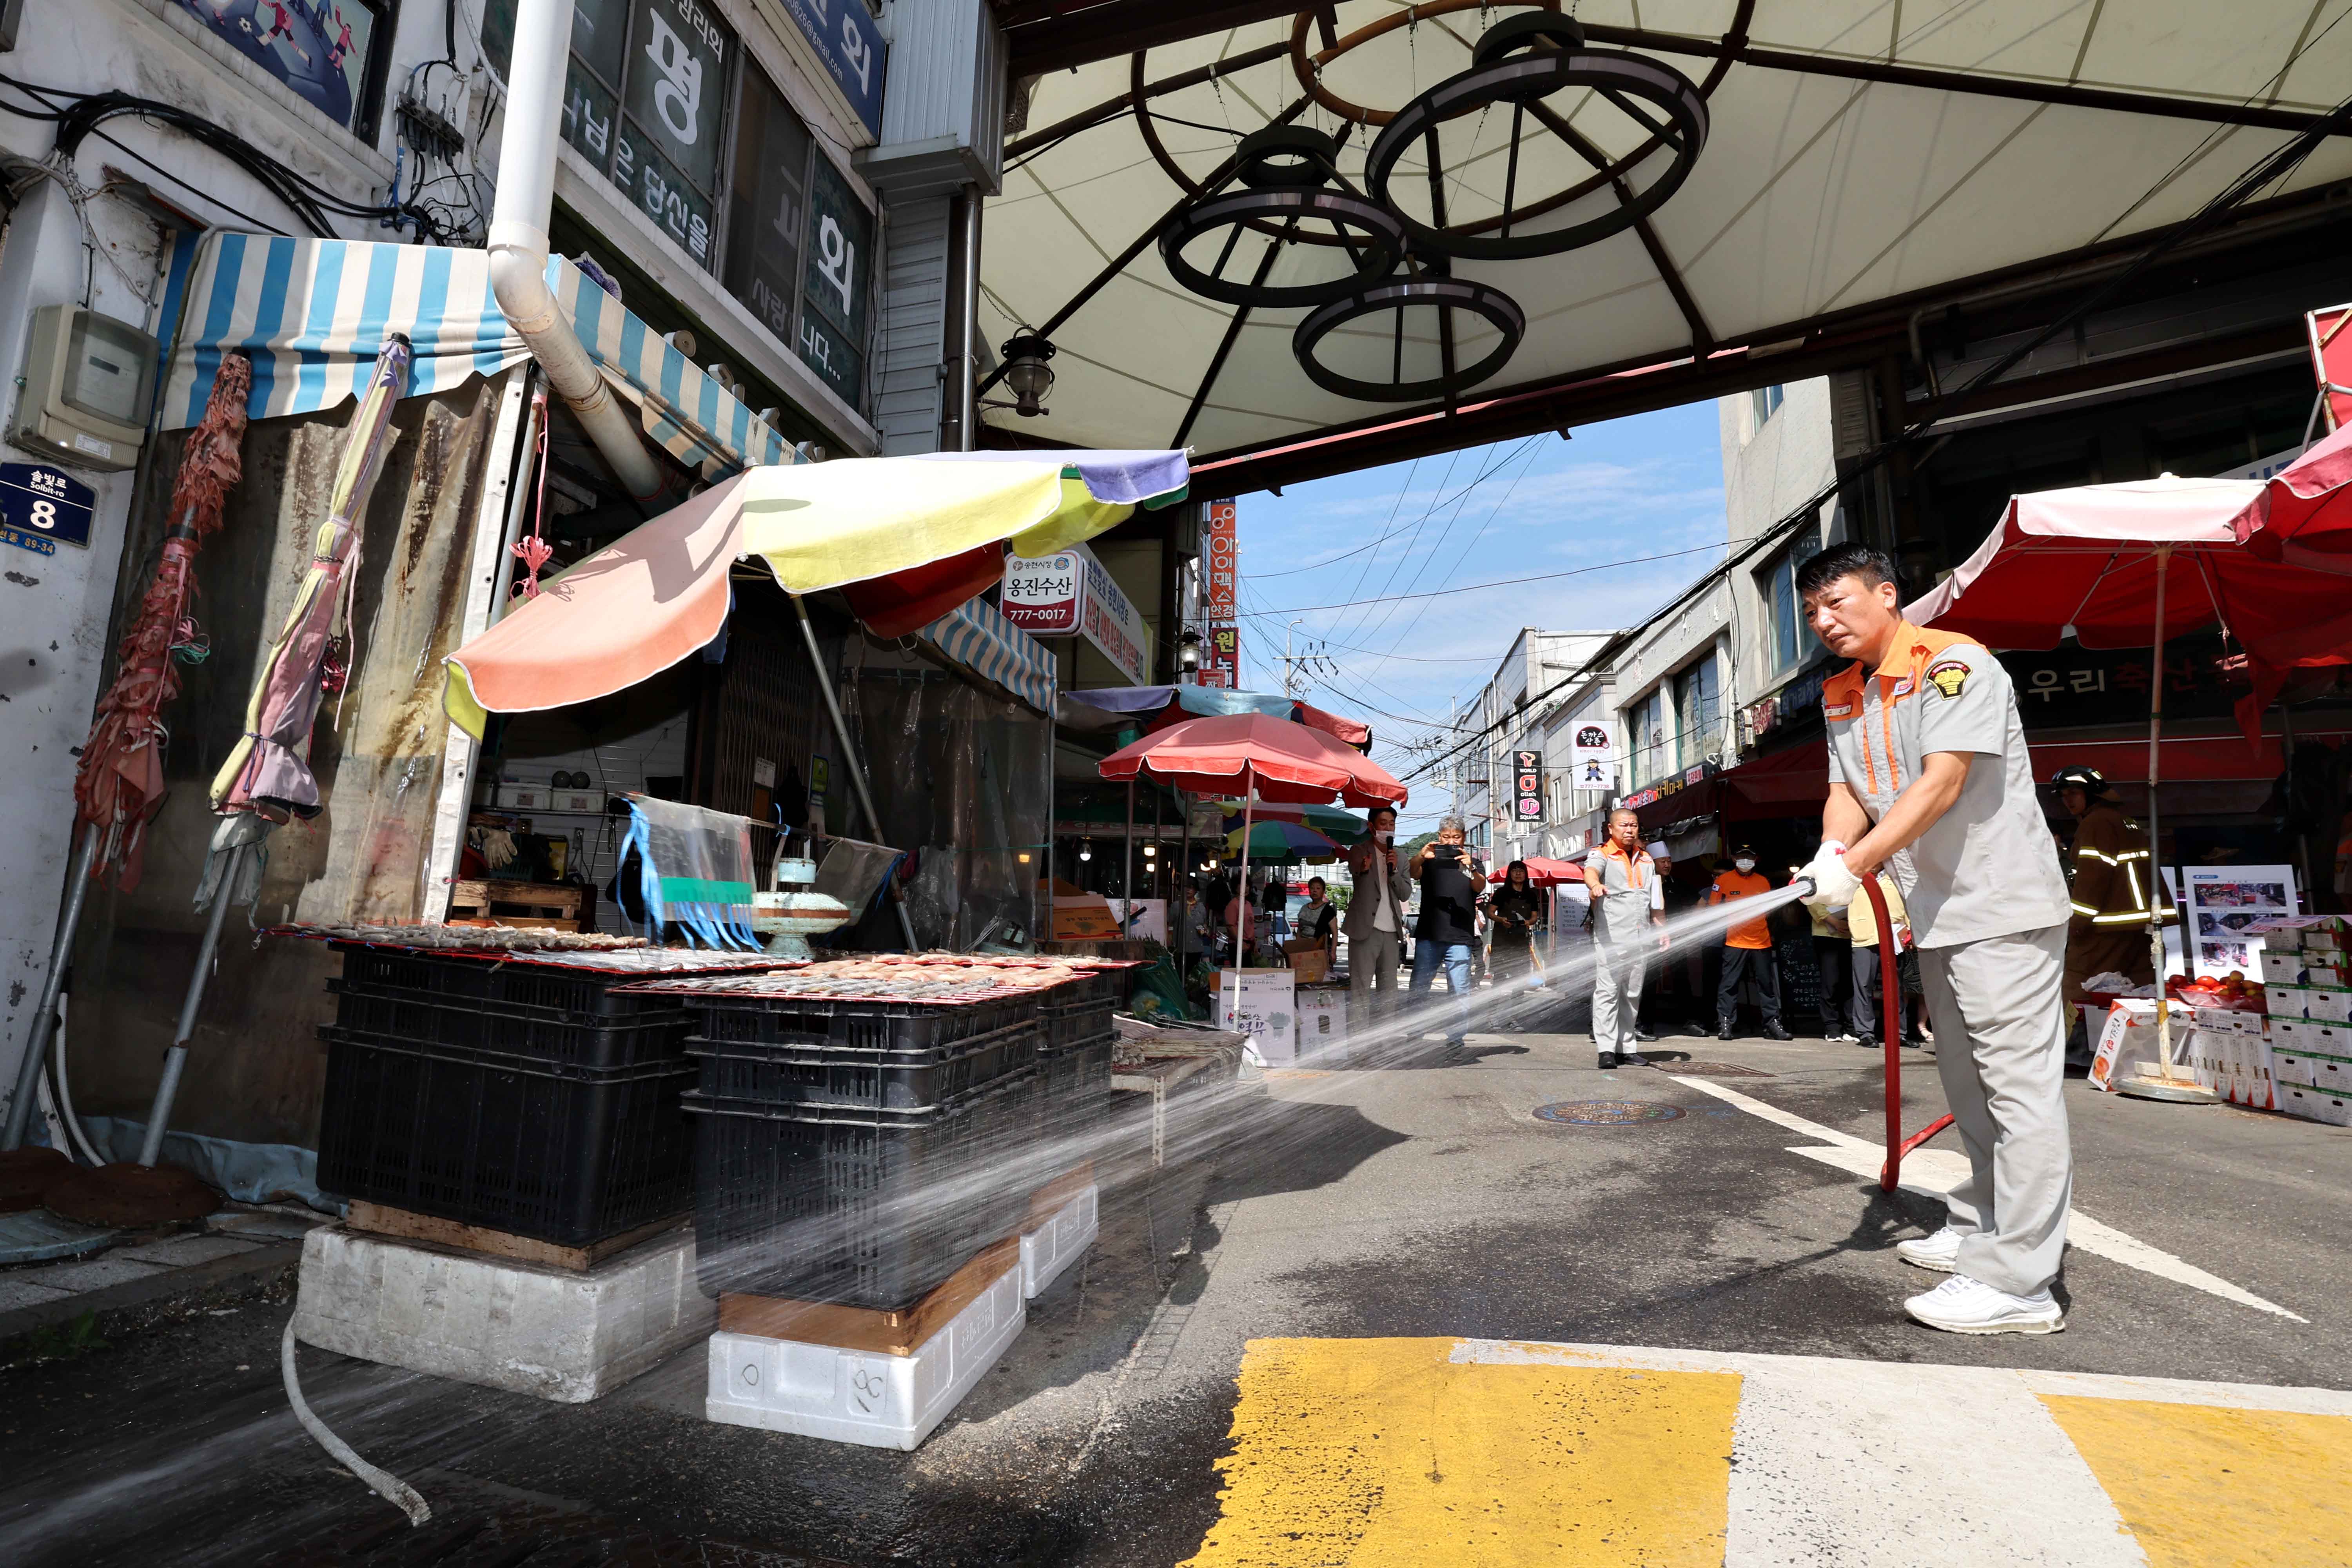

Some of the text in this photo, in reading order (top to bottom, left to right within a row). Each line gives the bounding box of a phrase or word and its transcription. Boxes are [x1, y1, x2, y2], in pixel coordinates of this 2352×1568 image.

[670, 0, 723, 63] 감리회
[787, 0, 843, 81] 0626@gmail.com
[644, 165, 708, 259] 당신을
[30, 481, 65, 497] Solbit-ro
[31, 470, 67, 489] 솔빛로
[30, 500, 56, 529] 8
[25, 538, 54, 553] 89-34
[1212, 536, 1234, 602] 아이맥스
[1007, 577, 1073, 597] 옹진수산
[1010, 610, 1067, 621] 777-0017
[1210, 604, 1233, 618] 안경
[2027, 669, 2105, 702] 우리
[1581, 731, 1604, 739] 돈까스
[1585, 737, 1601, 746] 삼촌
